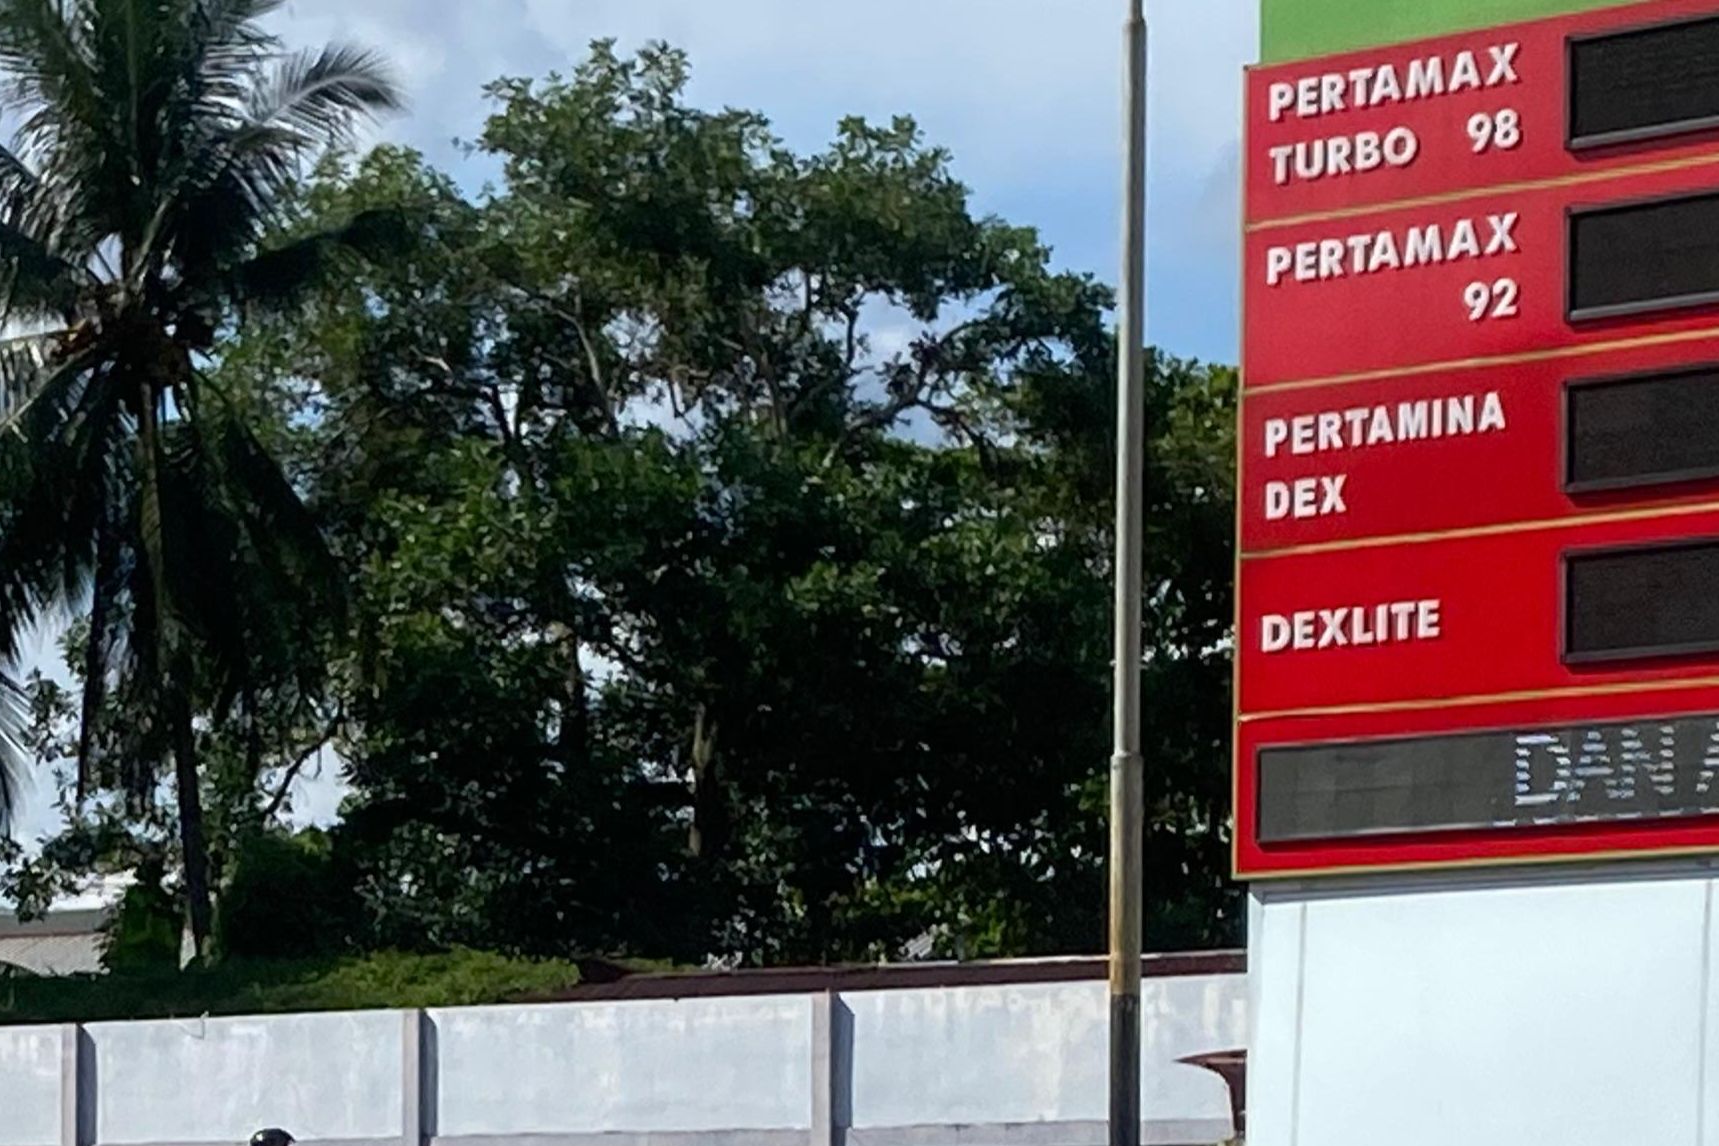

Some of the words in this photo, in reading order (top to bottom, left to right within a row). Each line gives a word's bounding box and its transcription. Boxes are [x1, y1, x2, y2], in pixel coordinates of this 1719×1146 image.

[1268, 42, 1520, 121] PERTAMAX
[1269, 126, 1419, 185] TURBO
[1466, 107, 1521, 154] 98
[1265, 211, 1519, 285] PERTAMAX
[1462, 278, 1519, 321] 92
[1264, 391, 1507, 459] PERTAMINA
[1264, 474, 1348, 520] DEX
[1260, 598, 1441, 653] DEXLITE
[1514, 725, 1675, 807] DAN
